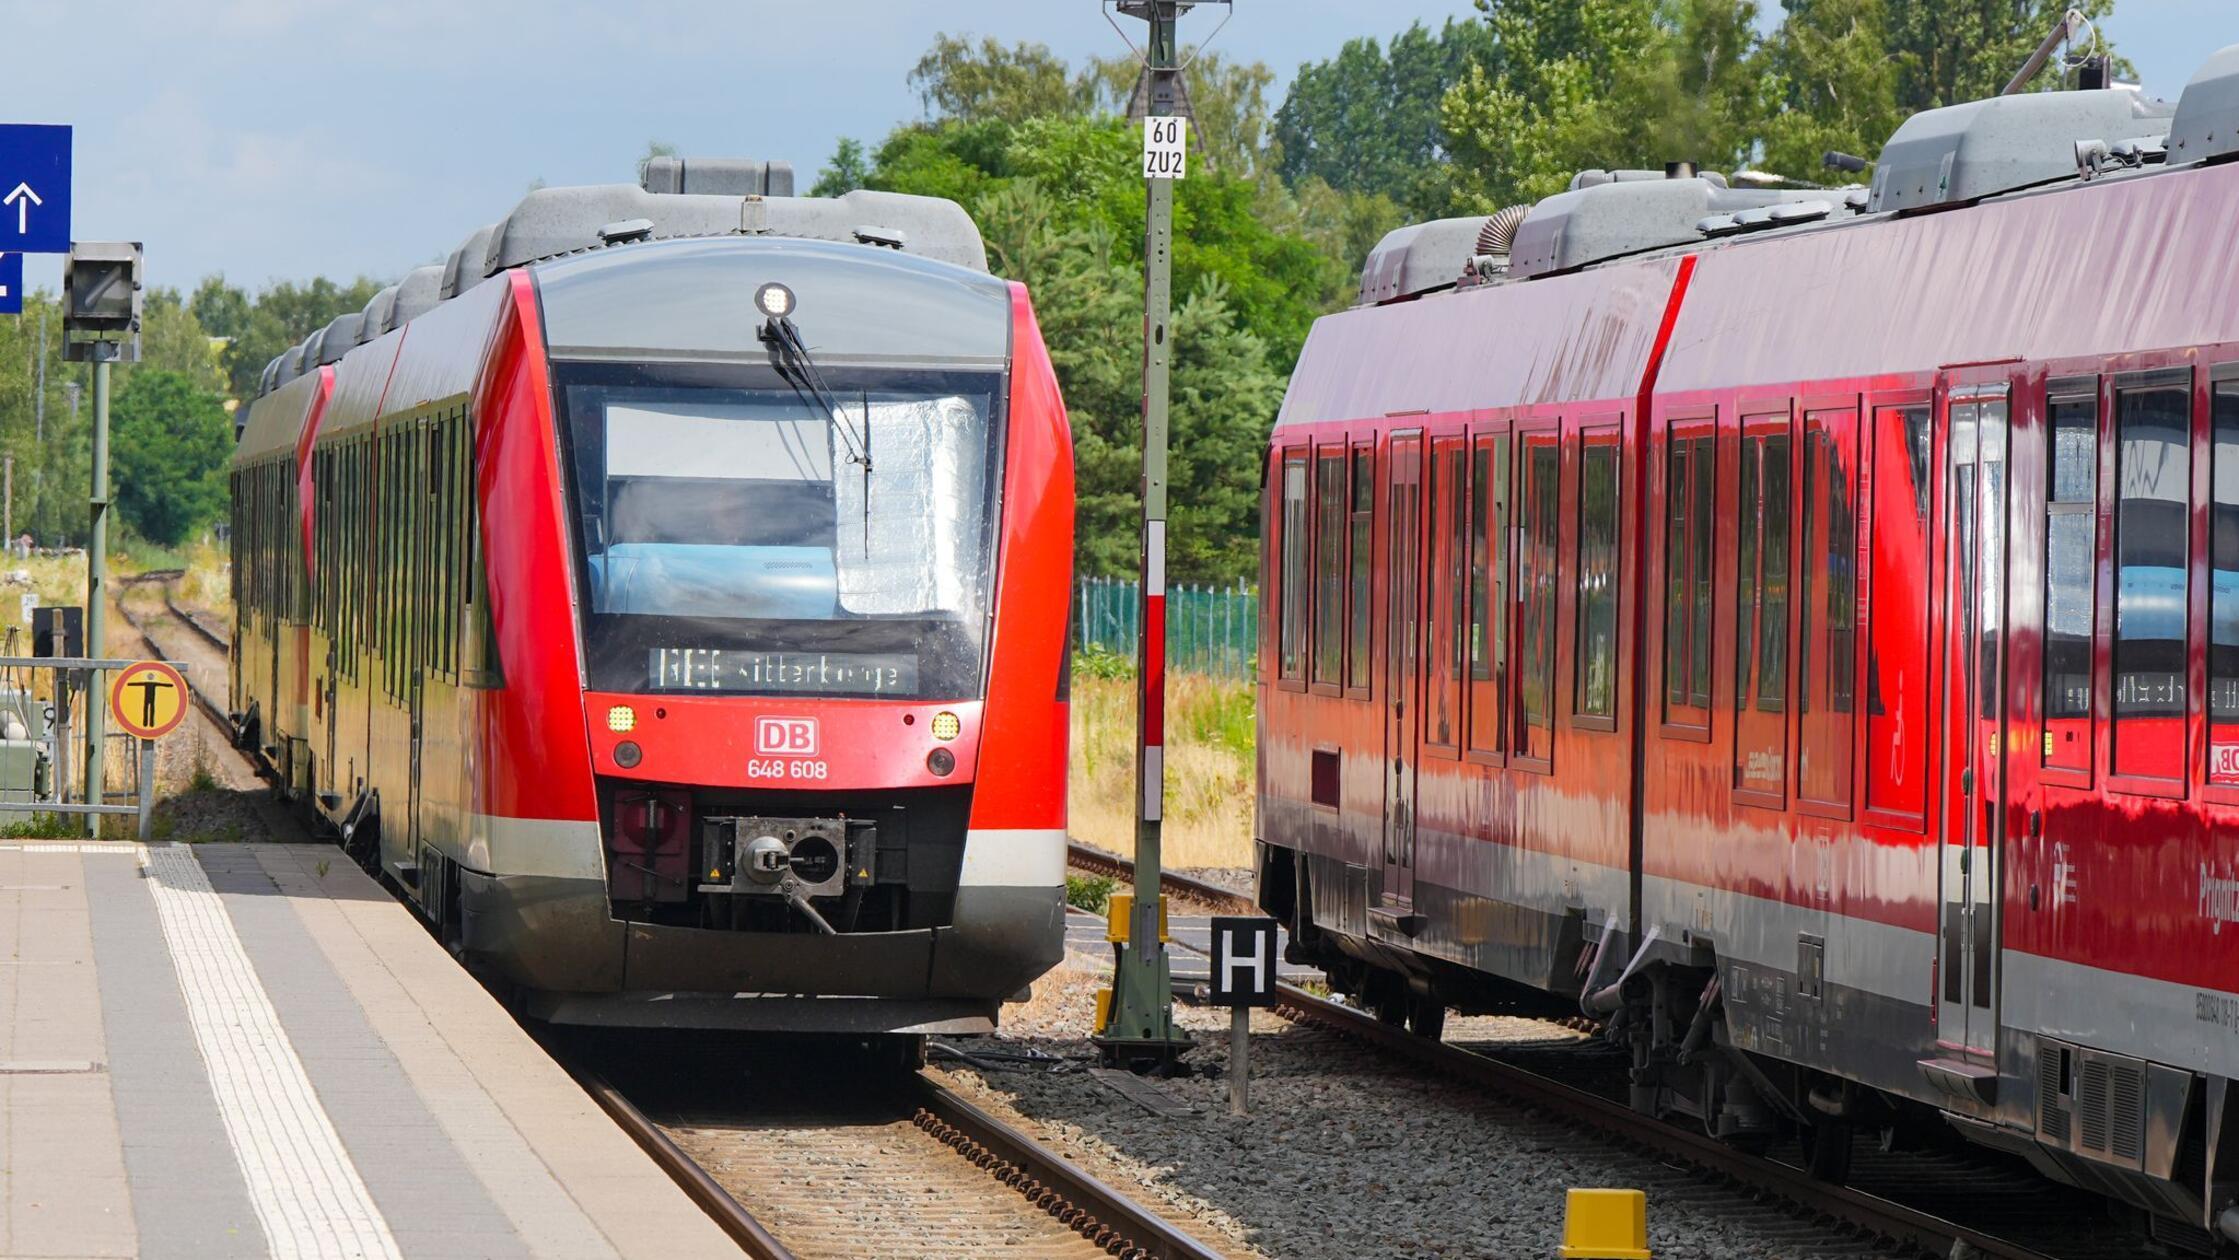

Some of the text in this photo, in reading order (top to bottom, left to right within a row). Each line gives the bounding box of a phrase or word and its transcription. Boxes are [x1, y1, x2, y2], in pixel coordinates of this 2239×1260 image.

[1153, 121, 1177, 144] 60
[1147, 151, 1182, 173] ZU2
[762, 720, 813, 751] DB
[748, 759, 828, 779] 648 608
[1221, 930, 1265, 993] H
